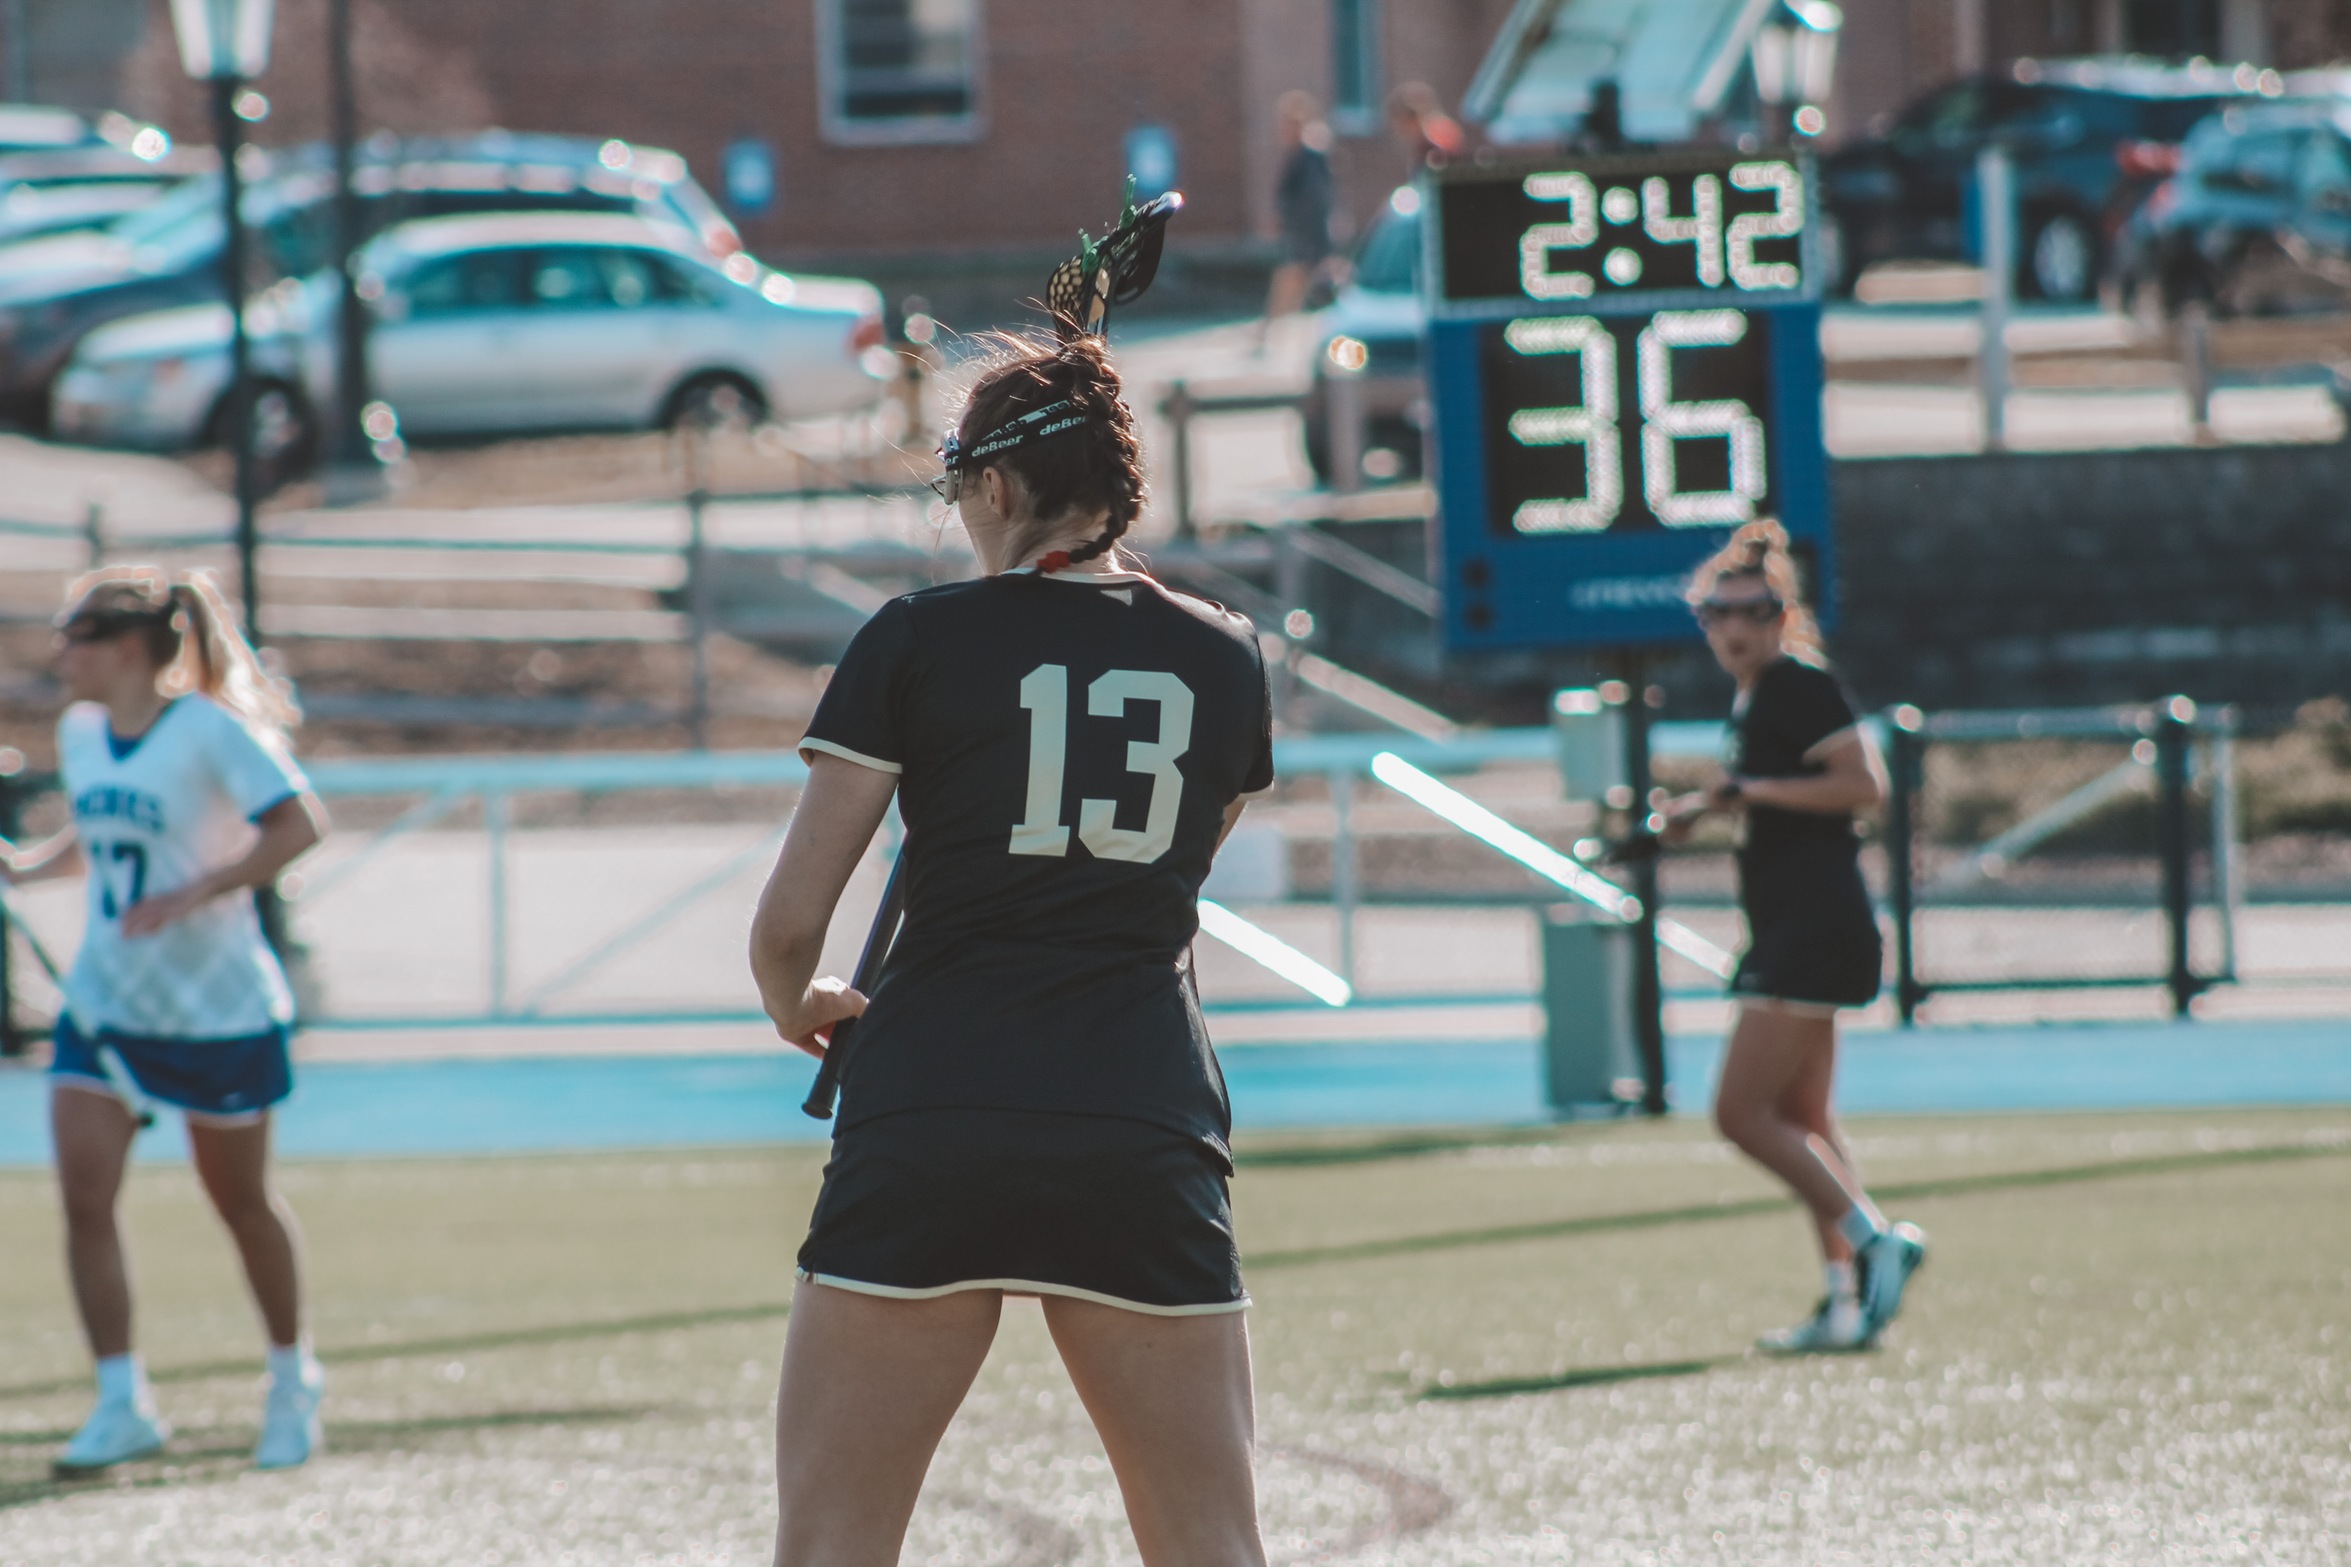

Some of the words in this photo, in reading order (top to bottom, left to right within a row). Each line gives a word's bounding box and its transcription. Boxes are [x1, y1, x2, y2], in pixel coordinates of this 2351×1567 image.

[1519, 161, 1802, 300] 2:42
[971, 434, 1024, 457] deBeer
[1504, 308, 1767, 534] 36
[1008, 663, 1195, 864] 13
